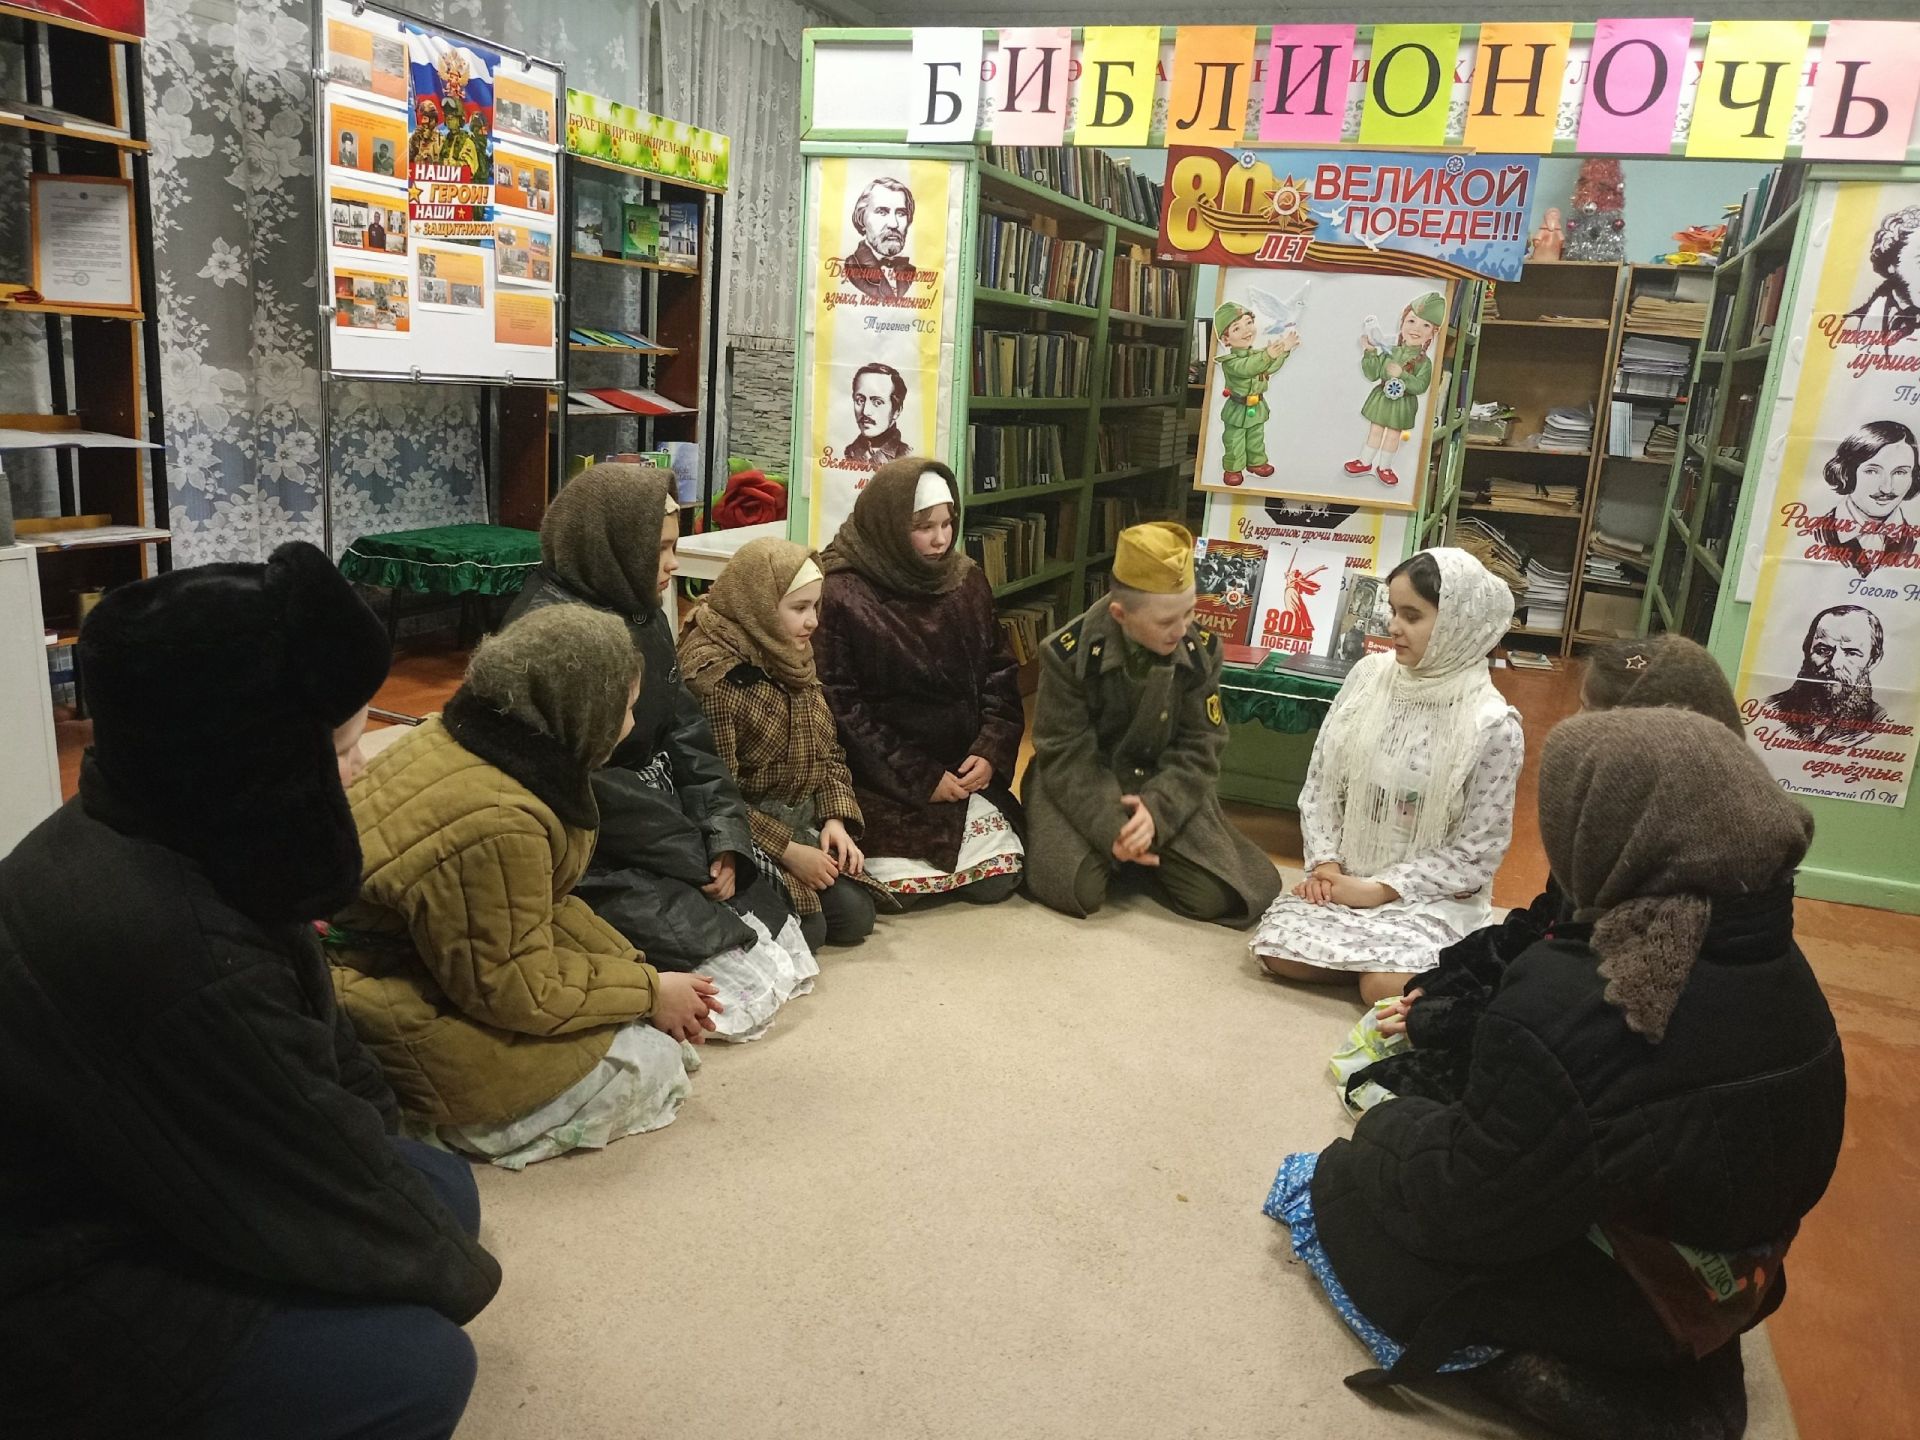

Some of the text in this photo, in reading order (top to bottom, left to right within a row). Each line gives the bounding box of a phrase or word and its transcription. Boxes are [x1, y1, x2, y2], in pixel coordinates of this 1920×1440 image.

[415, 164, 461, 182] НАШИ
[429, 183, 490, 205] ГЕРОИ!
[1313, 164, 1530, 208] ВЕЛИКОЙ
[415, 204, 456, 220] НАШИ
[1167, 156, 1273, 255] 80
[1344, 205, 1524, 245] ПОБЕДЕ!!!
[1255, 234, 1315, 263] ЛЕТ
[863, 316, 911, 334] Тургенев
[1848, 578, 1899, 599] Гоголь
[1264, 608, 1294, 634] 80
[1260, 635, 1313, 655] ПОБЕДА!
[1847, 745, 1907, 764] книги
[1802, 759, 1904, 784] серьёзные.
